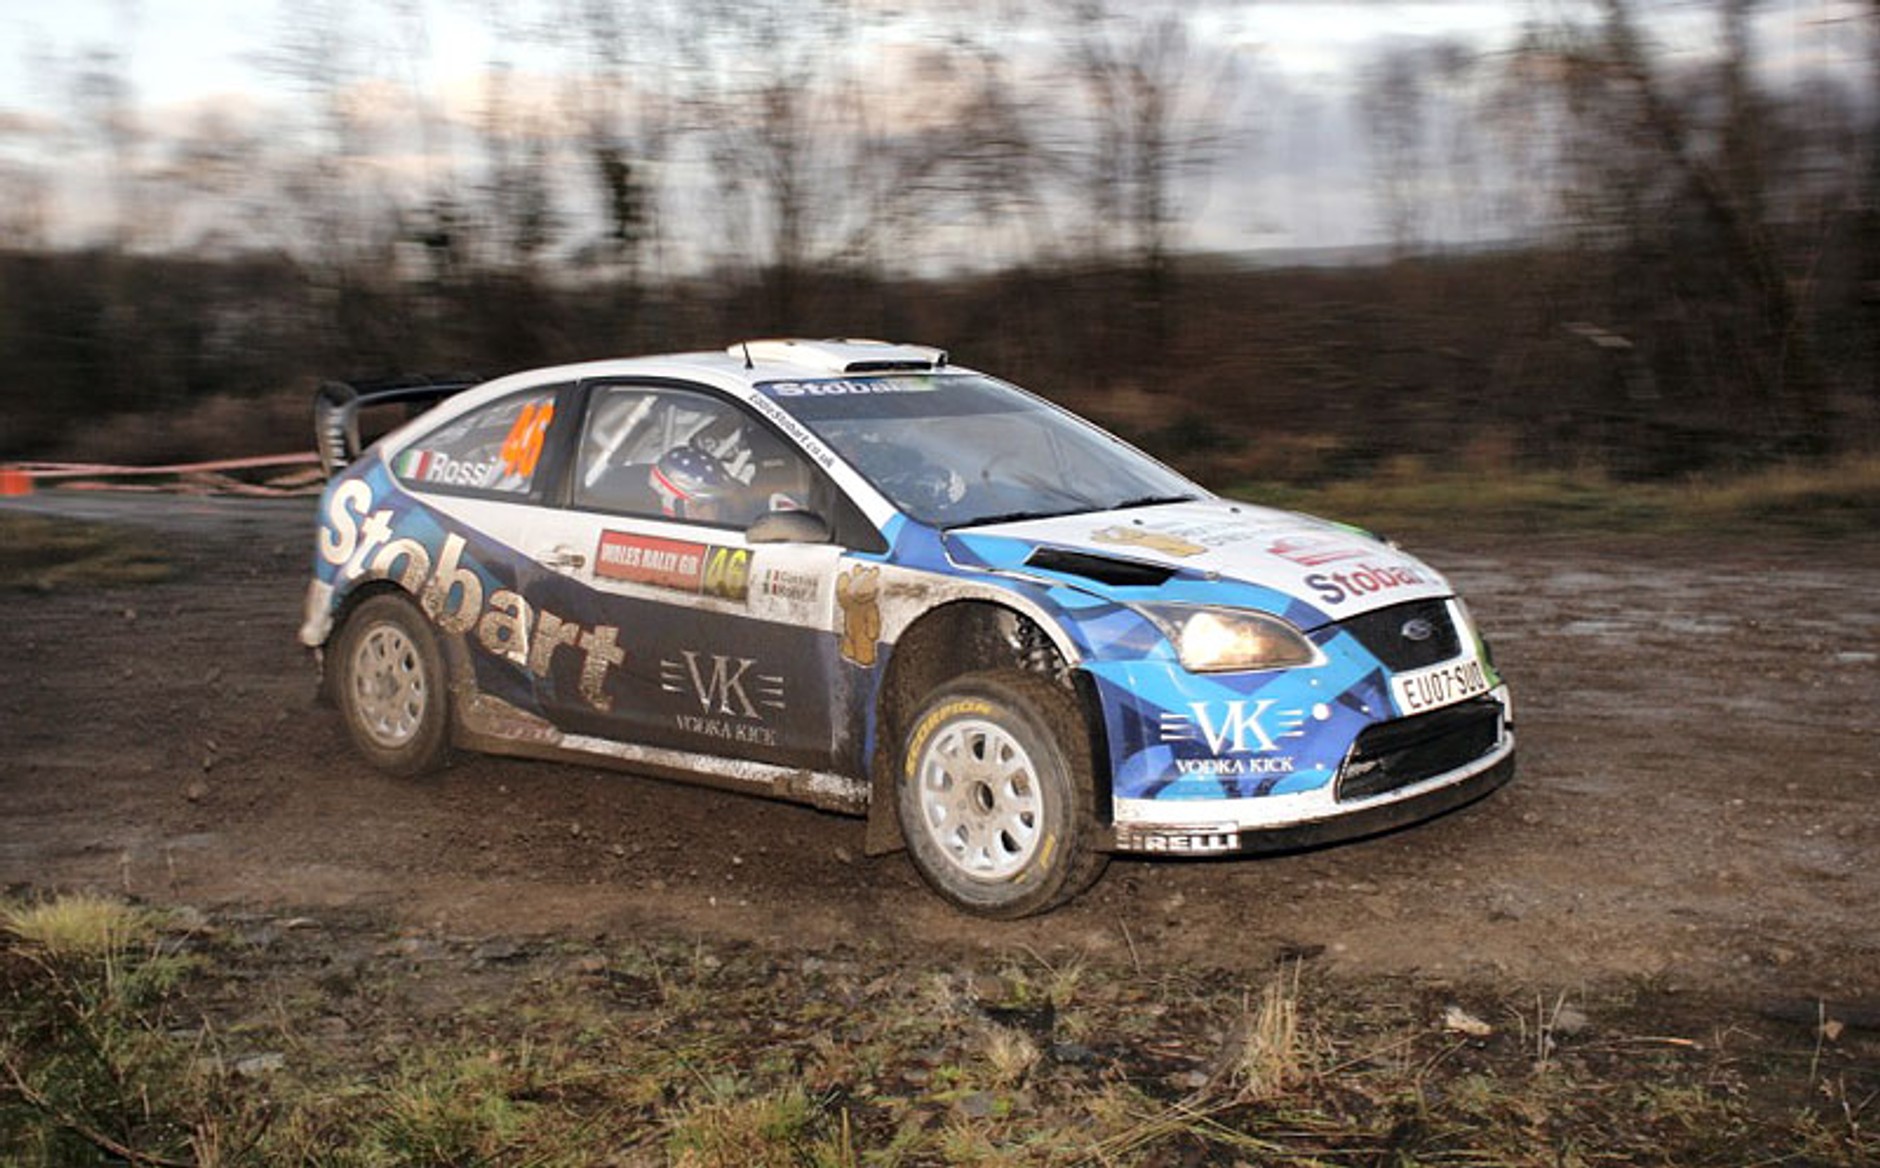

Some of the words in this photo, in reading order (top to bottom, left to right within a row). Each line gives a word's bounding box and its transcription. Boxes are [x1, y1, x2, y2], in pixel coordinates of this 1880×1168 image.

[501, 403, 555, 478] 46
[430, 451, 496, 486] Rossi
[601, 543, 642, 568] WALES
[641, 549, 679, 572] RALLY
[706, 547, 748, 597] 46
[319, 478, 627, 711] Stobart
[681, 650, 763, 719] VK
[1402, 669, 1453, 710] EU07
[676, 714, 732, 740] VODKA
[735, 723, 776, 747] KICK
[1187, 698, 1280, 756] VK
[1174, 758, 1245, 775] VODKA
[1250, 756, 1295, 773] KICK
